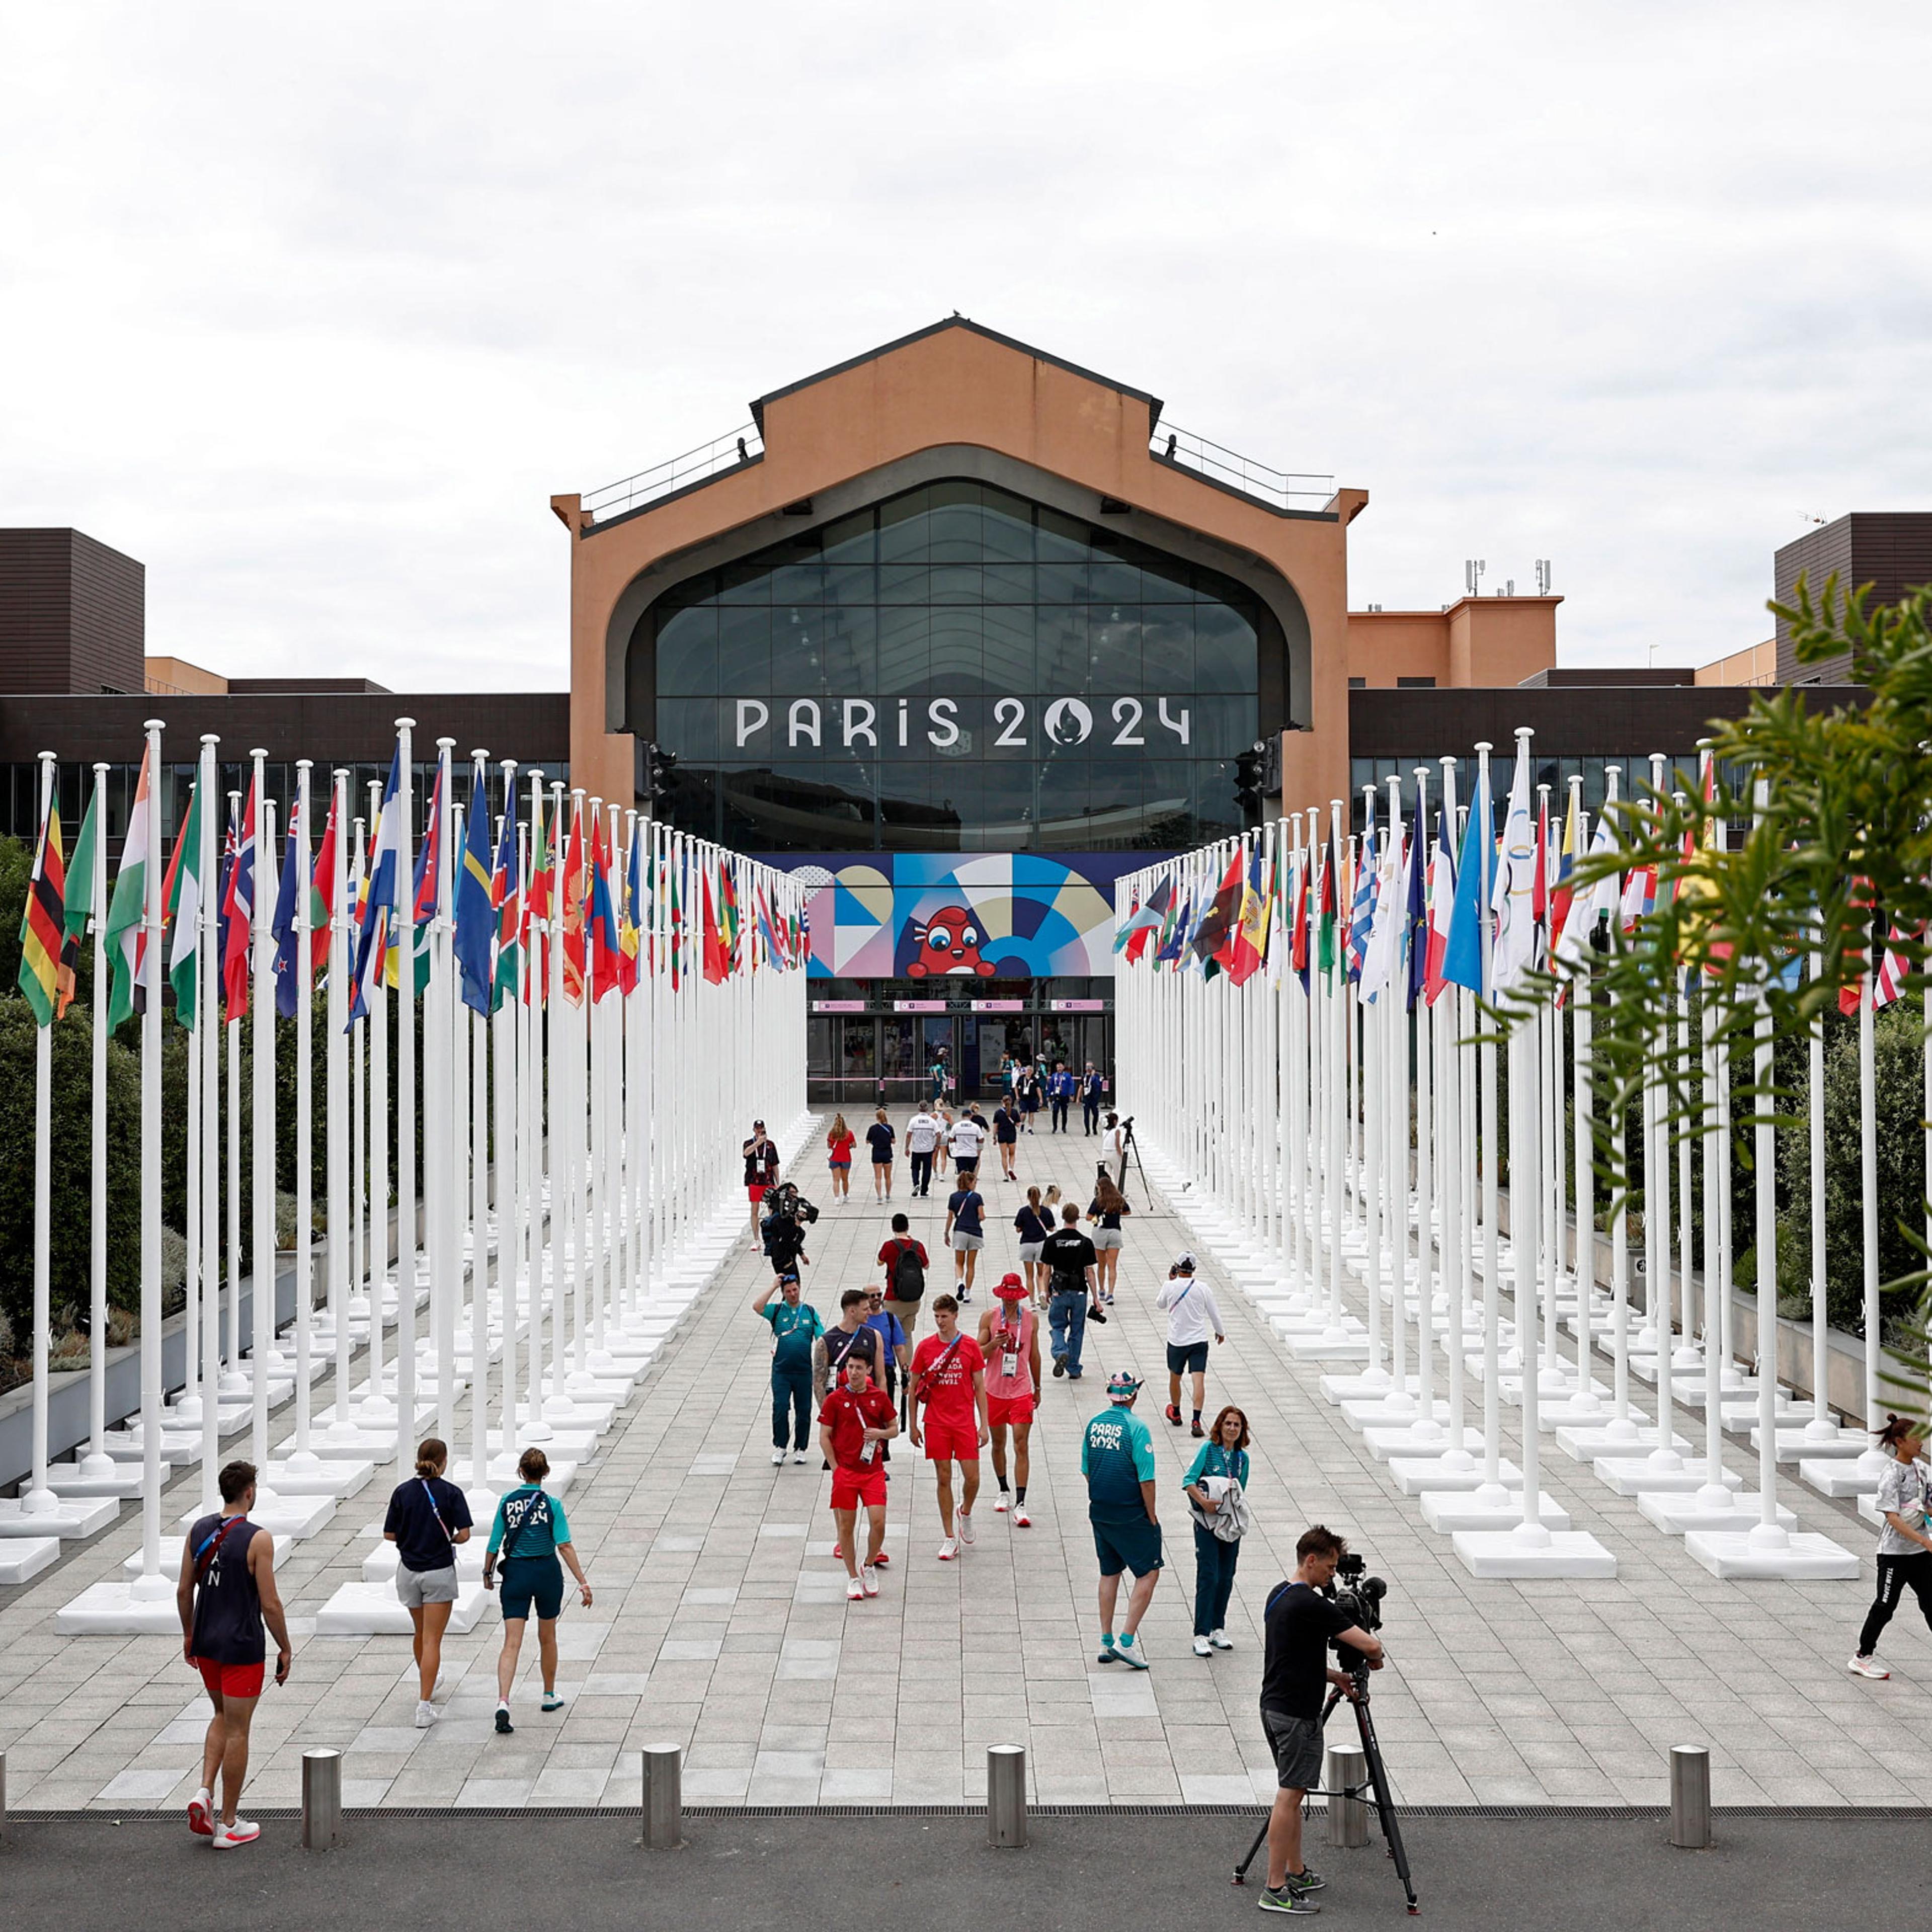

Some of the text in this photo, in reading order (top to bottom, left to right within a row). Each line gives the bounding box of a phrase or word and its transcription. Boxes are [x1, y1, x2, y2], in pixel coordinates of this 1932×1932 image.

[994, 697, 1189, 746] 2024
[1091, 1423, 1122, 1437] PARIS
[1090, 1435, 1120, 1450] 2024
[1882, 1584, 1890, 1603] JAPAN
